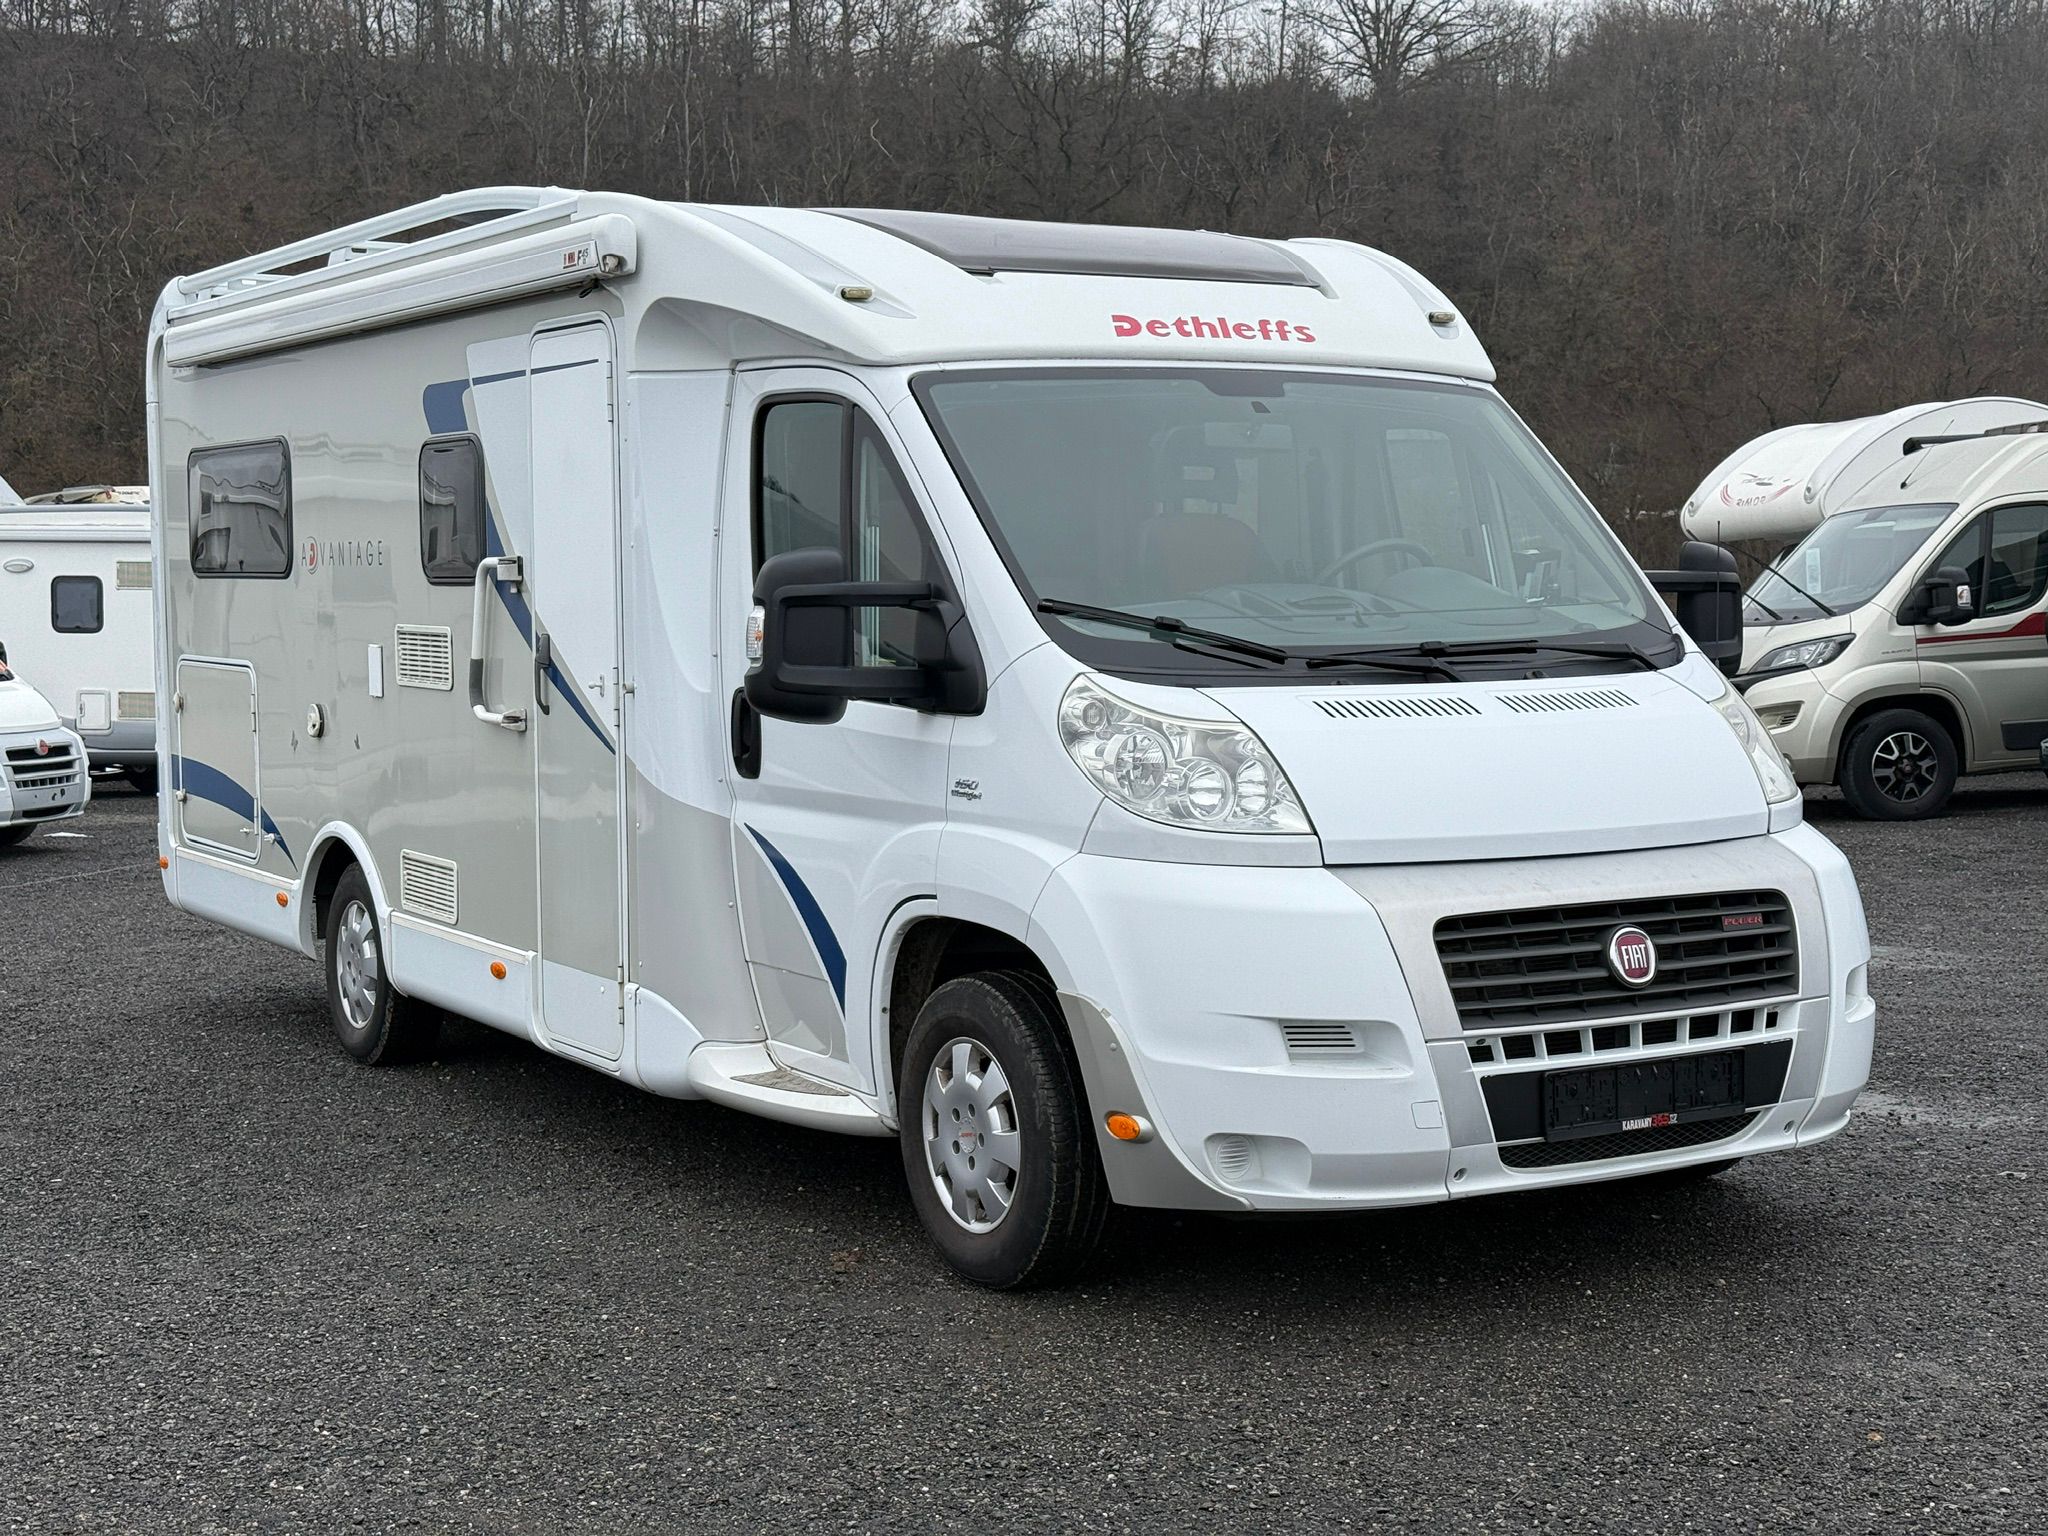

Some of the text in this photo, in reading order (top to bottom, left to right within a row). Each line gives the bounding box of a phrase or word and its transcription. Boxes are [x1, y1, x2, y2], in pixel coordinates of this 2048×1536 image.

[1111, 315, 1316, 343] Dethleffs
[1724, 916, 1762, 926] POWER
[1621, 944, 1648, 970] FIAT
